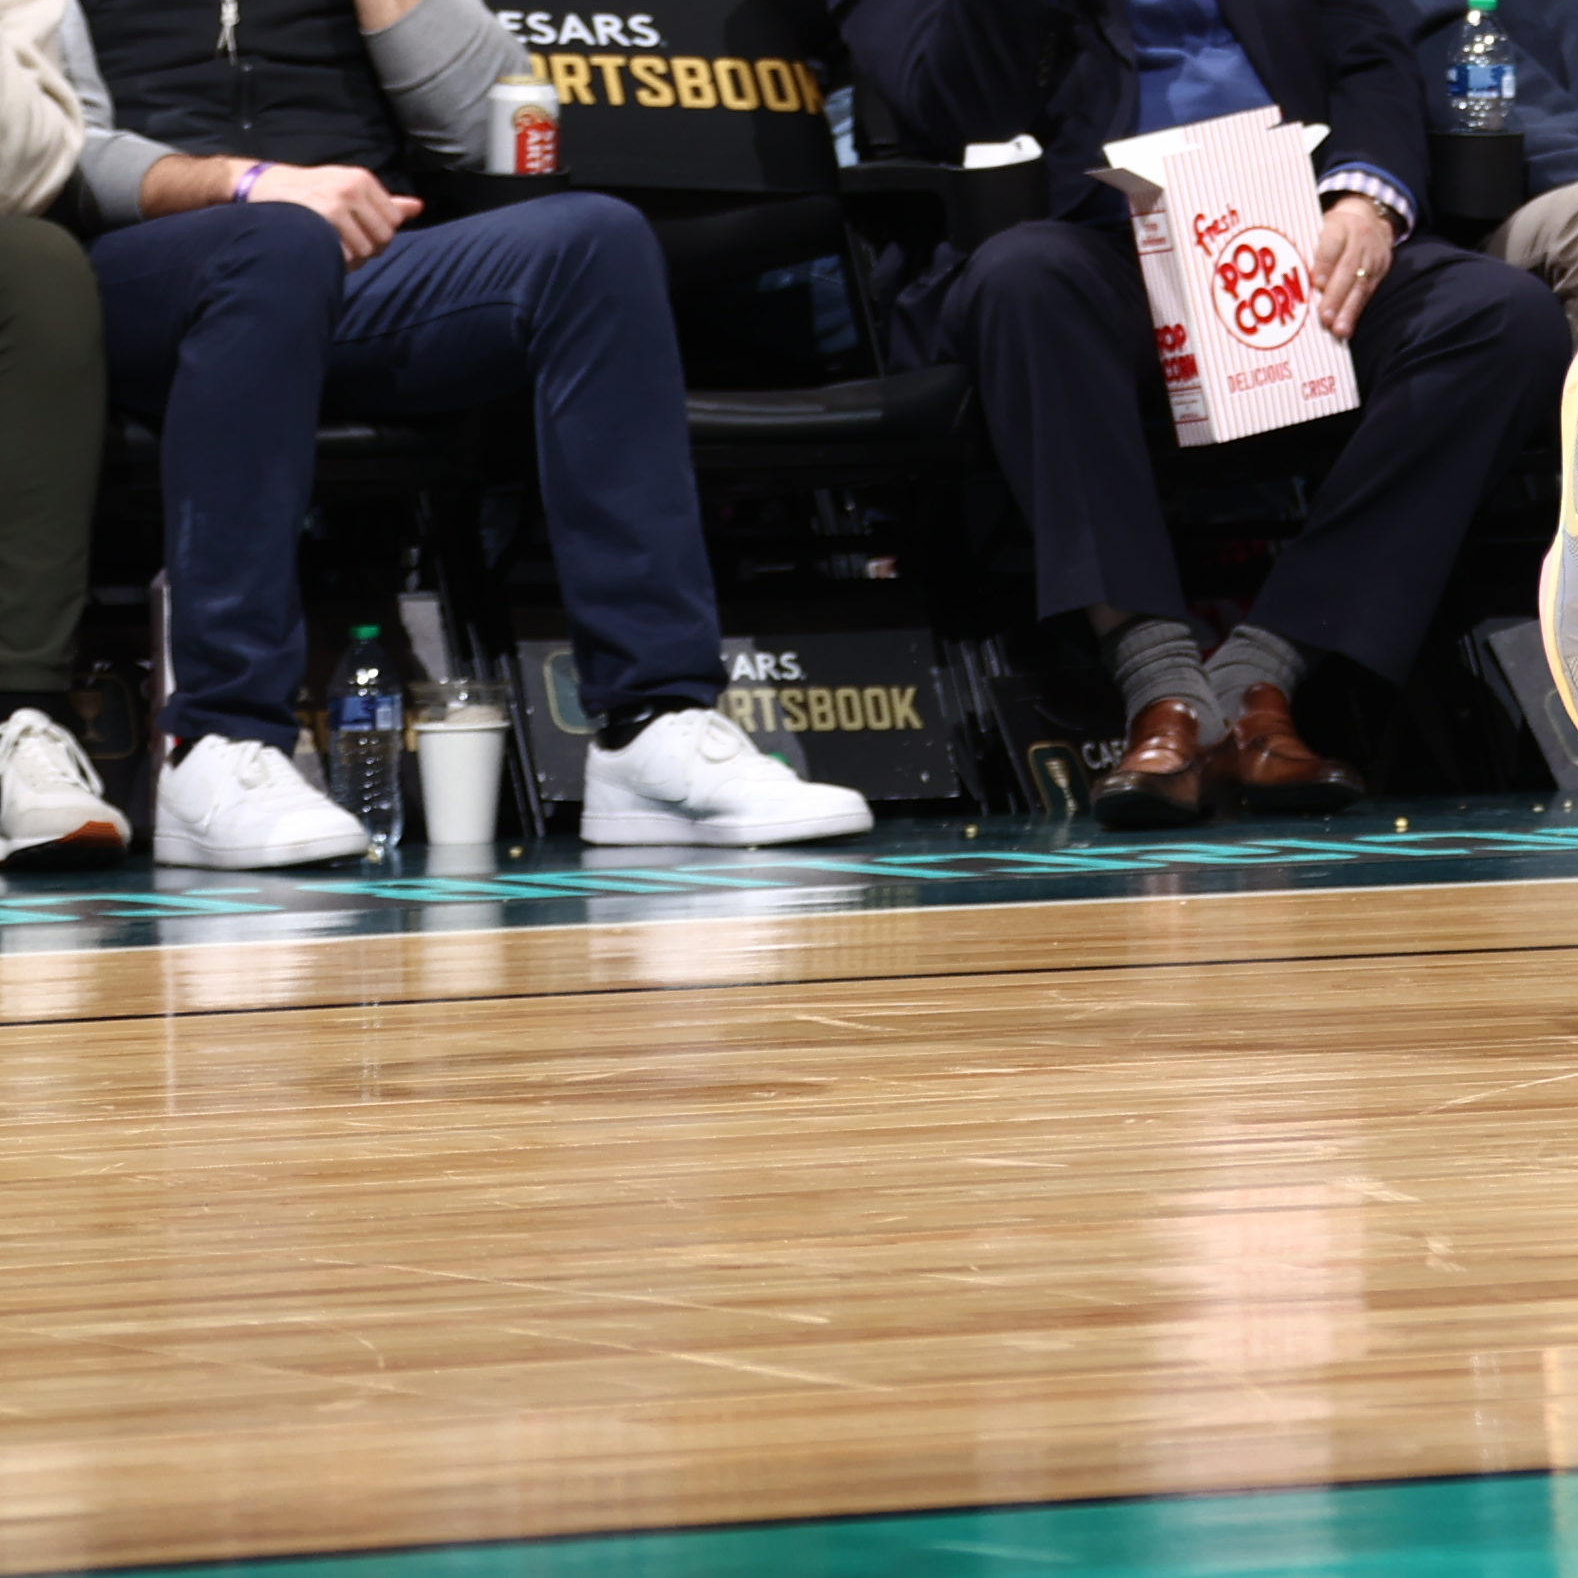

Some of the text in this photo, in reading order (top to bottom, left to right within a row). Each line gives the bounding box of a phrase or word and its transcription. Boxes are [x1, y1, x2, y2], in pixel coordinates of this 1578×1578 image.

[1193, 204, 1240, 257] fresh
[1217, 243, 1277, 300] POP
[1235, 267, 1306, 336] CORN
[1227, 361, 1294, 395] DELICIOUS
[1302, 375, 1337, 402] CRISP
[717, 686, 924, 733] RTSBOOK
